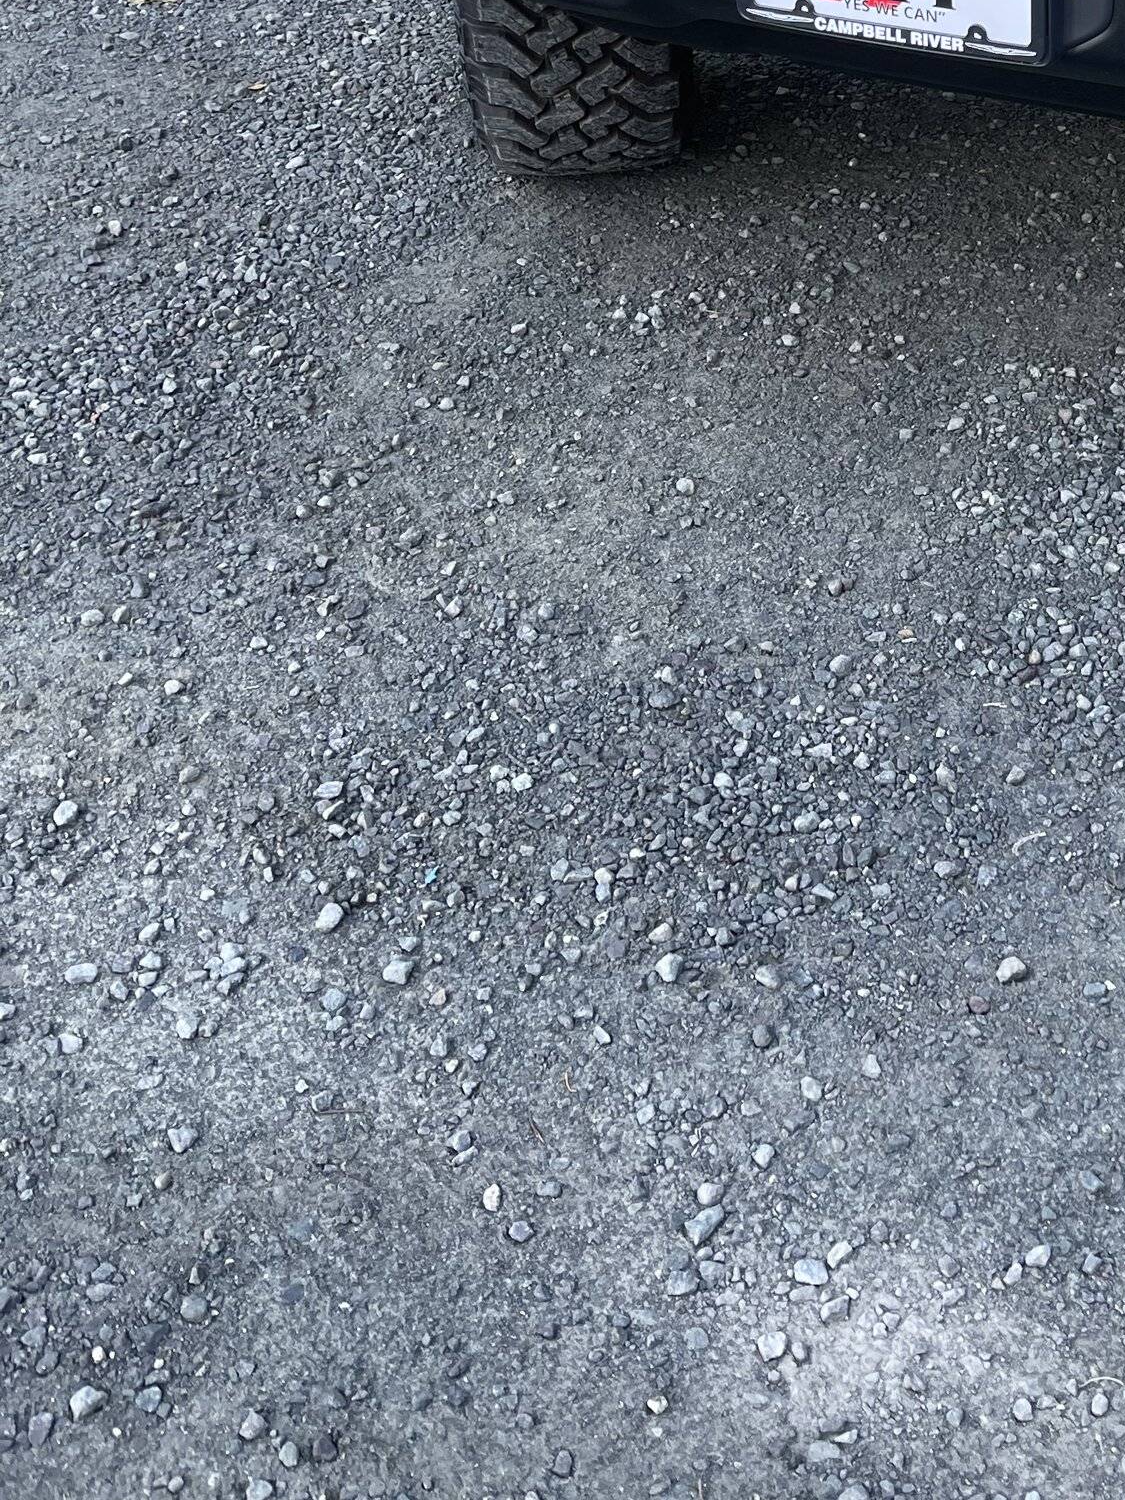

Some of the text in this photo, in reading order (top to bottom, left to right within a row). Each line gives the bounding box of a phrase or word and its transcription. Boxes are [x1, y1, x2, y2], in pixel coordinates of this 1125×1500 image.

[874, 2, 900, 18] WE
[813, 15, 965, 53] CAMPBELL RIVER
